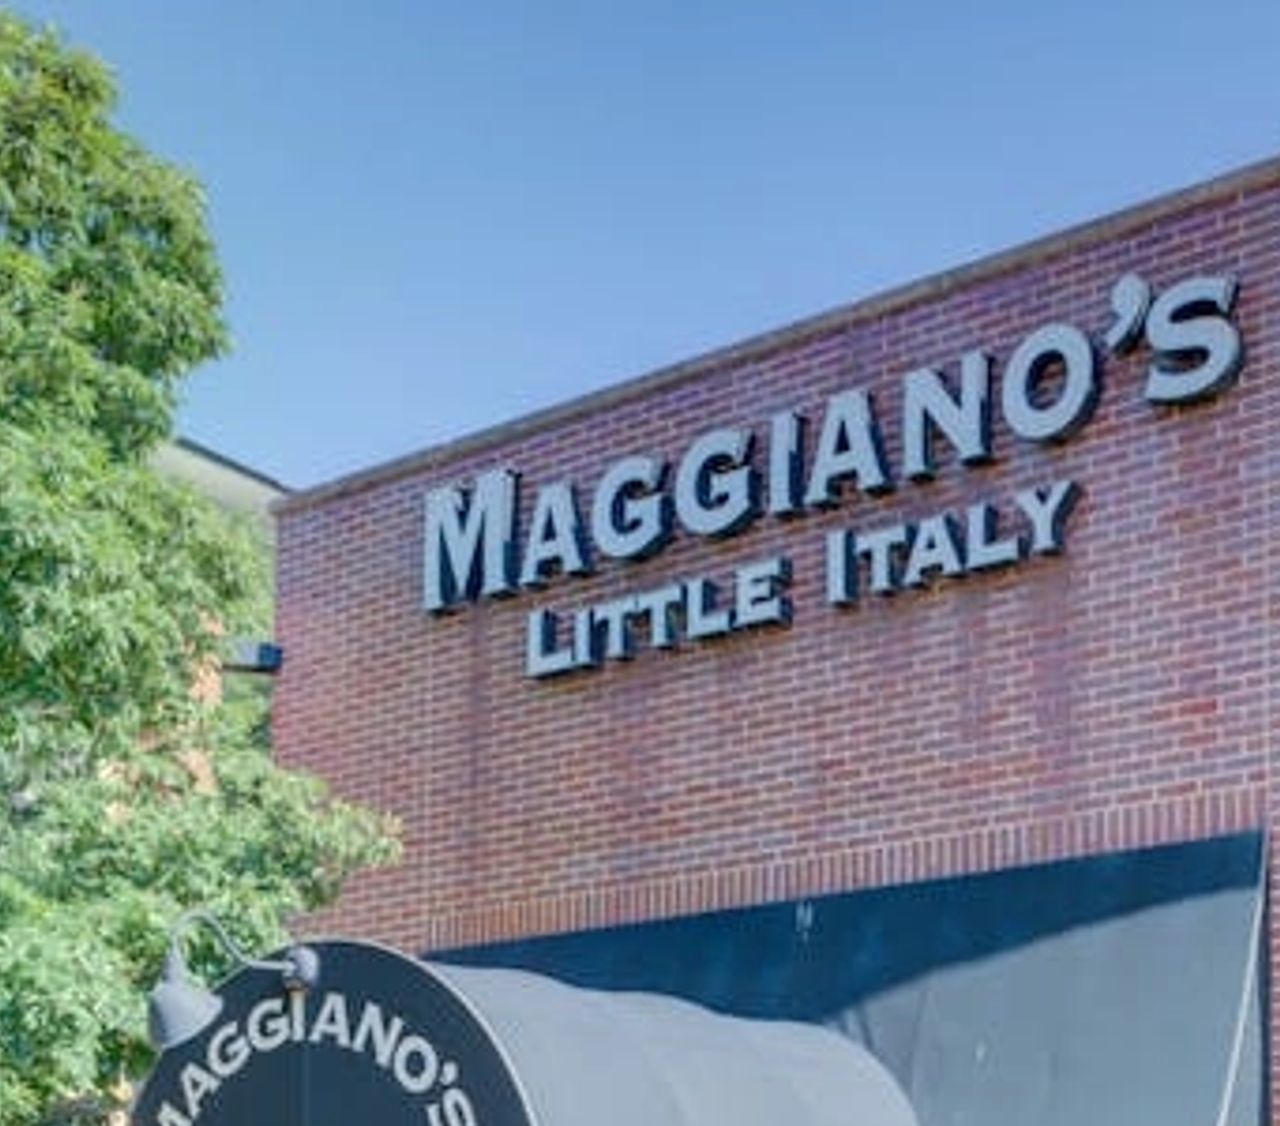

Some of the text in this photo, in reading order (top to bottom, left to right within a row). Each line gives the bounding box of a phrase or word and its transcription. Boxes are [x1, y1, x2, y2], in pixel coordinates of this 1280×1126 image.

[422, 272, 1244, 613] MAGGIANO'S
[526, 479, 1076, 678] LITTLE ITALY
